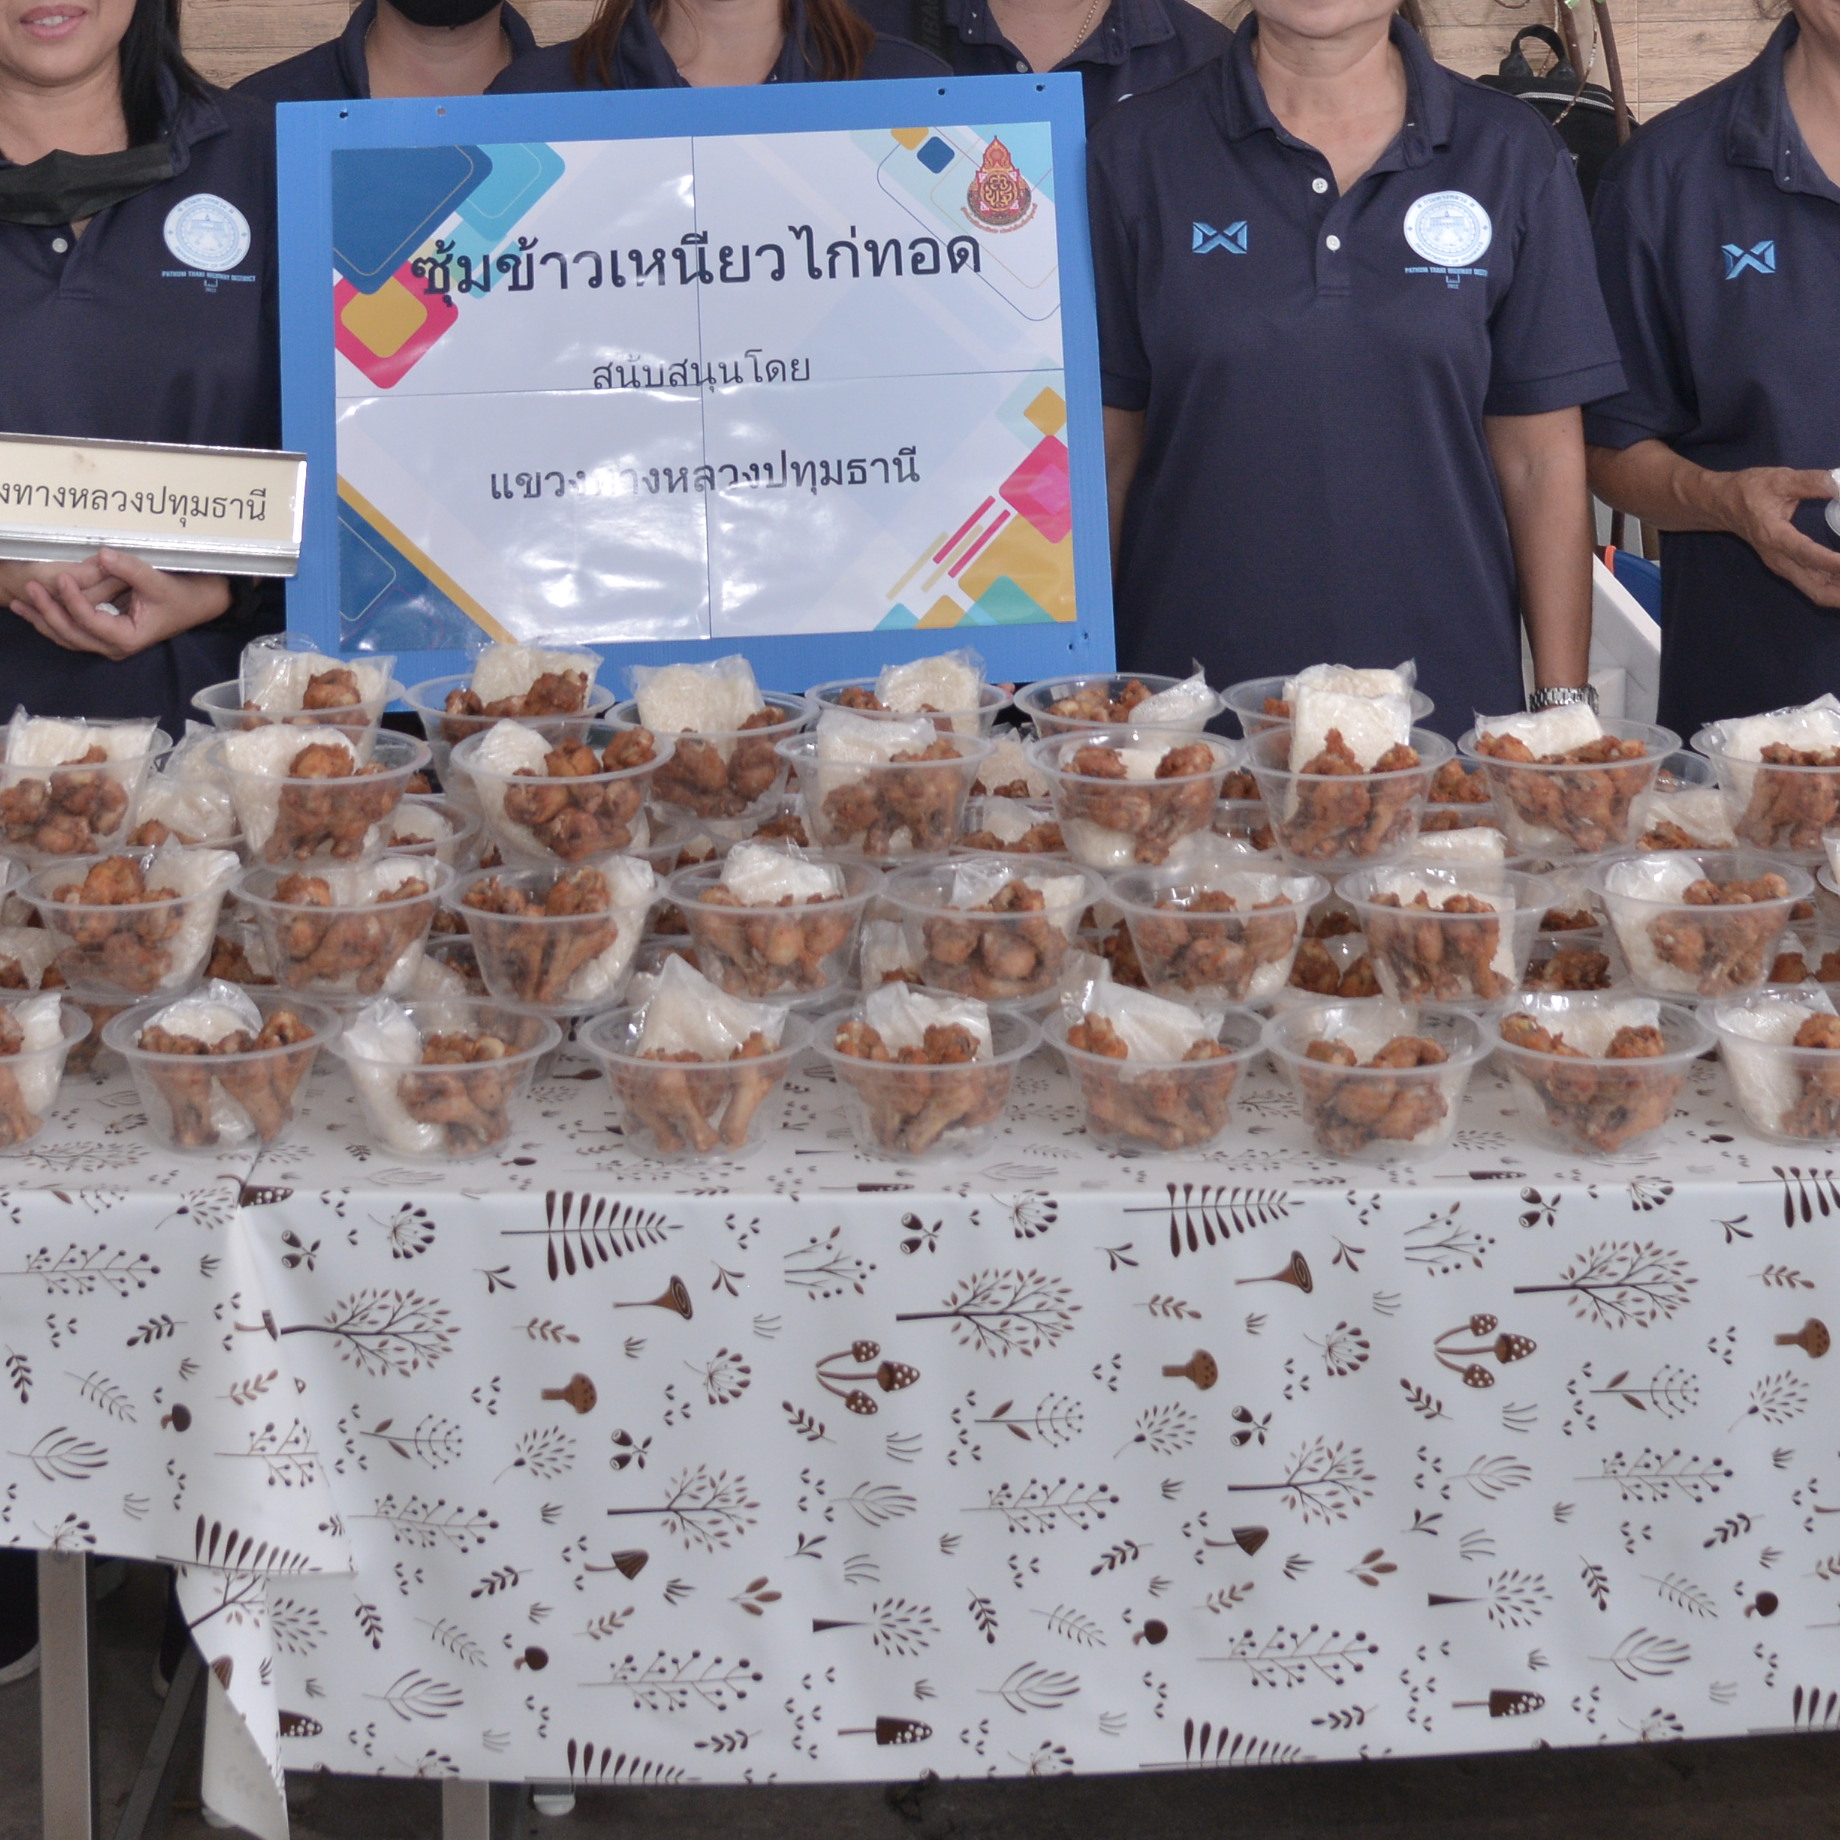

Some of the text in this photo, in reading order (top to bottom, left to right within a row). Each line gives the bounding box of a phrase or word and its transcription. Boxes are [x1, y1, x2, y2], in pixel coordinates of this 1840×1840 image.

[410, 224, 983, 308] ซุ้มข้าวเหนียวไก่ทอด
[593, 348, 811, 393] สนับสนุนโดย
[490, 445, 922, 503] แขวงางหลวงปทุมธานี
